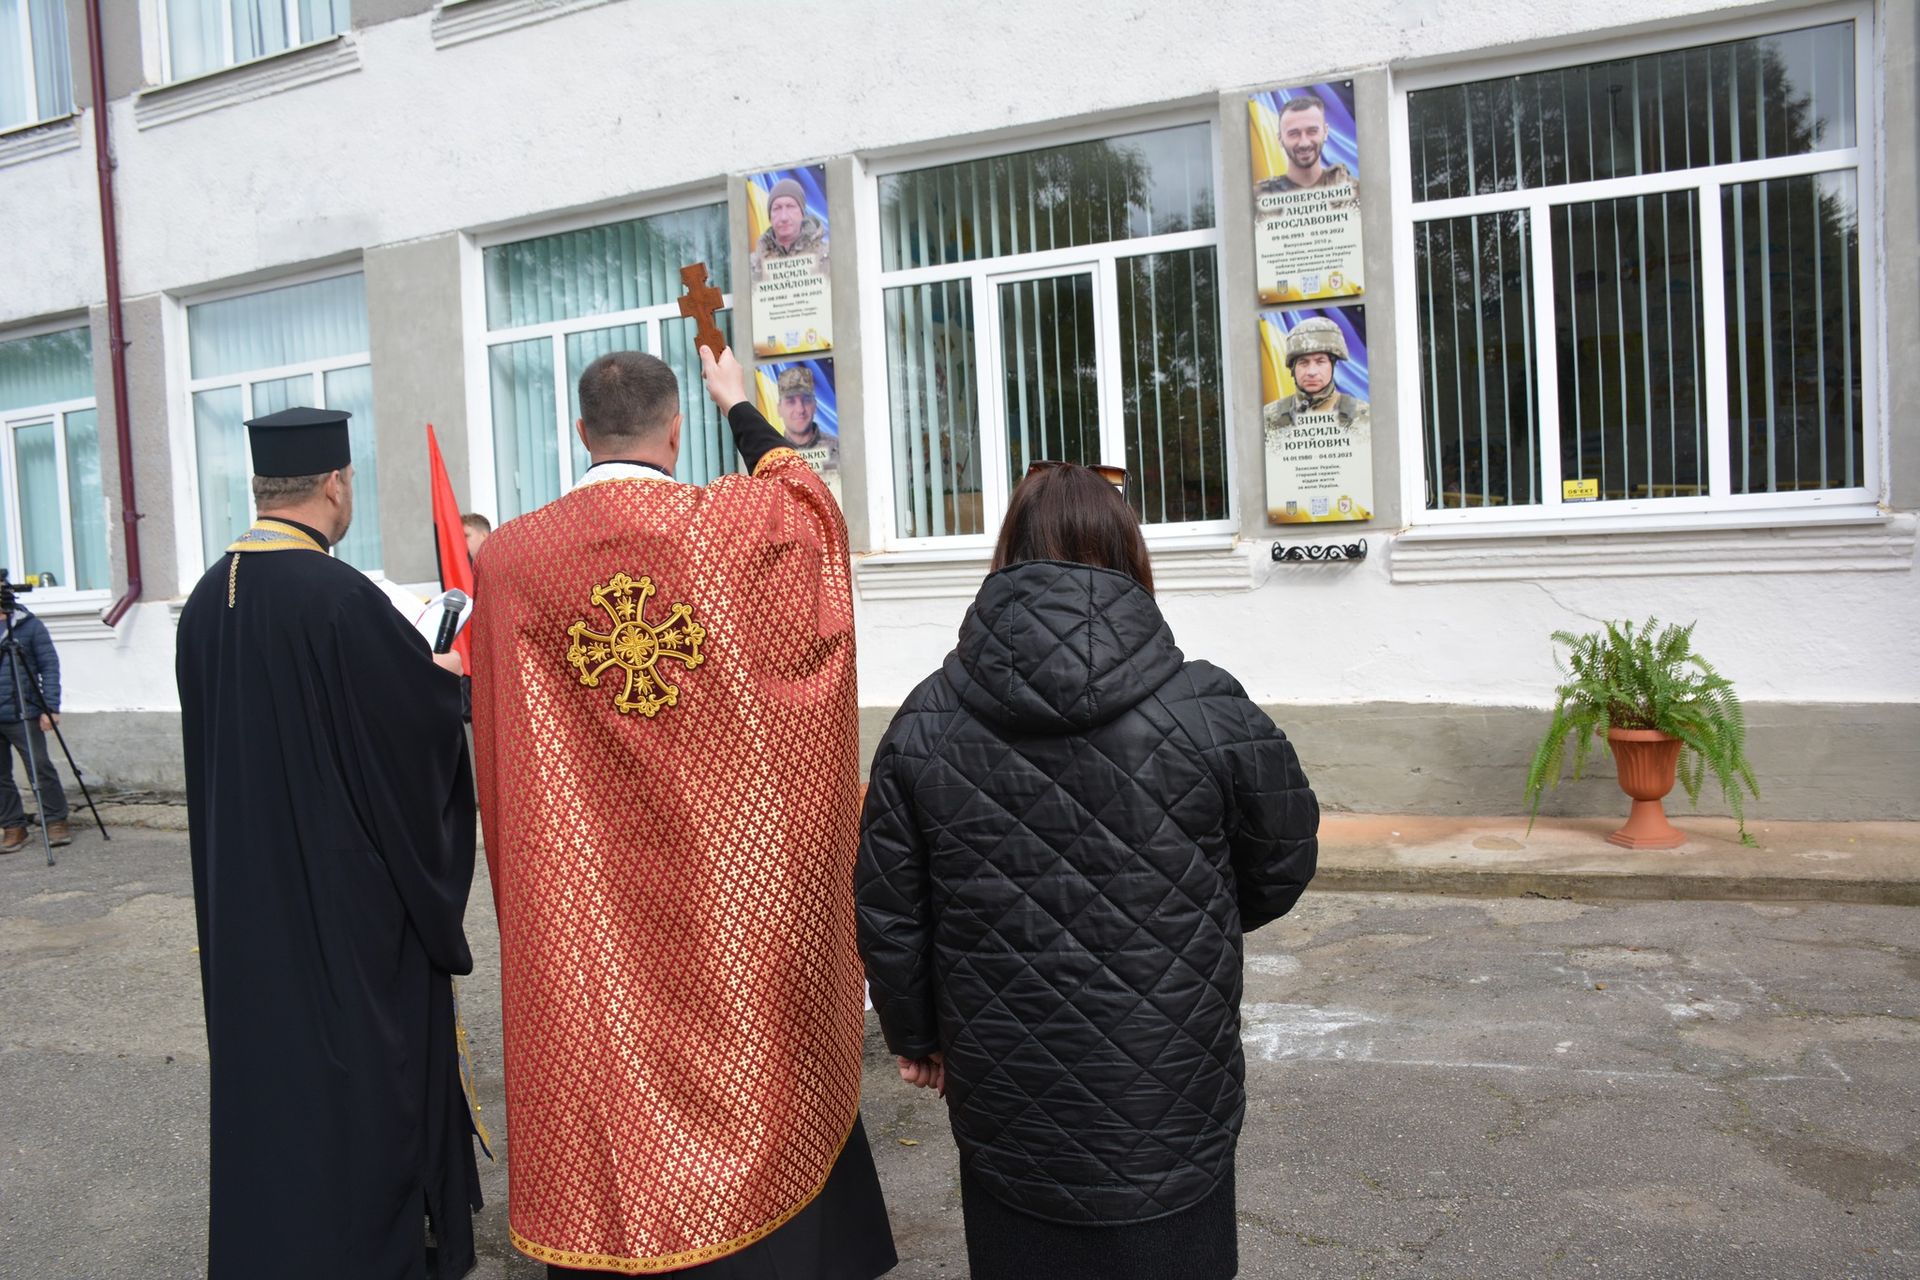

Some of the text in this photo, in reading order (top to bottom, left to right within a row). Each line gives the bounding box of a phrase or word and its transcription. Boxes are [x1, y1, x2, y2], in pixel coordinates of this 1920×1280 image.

[1261, 186, 1351, 207] СИНОВЕРСЬКИЙ
[1286, 202, 1327, 216] АНДРІЙ
[1267, 213, 1348, 231] ЯРОСЛАВОВИЧ
[767, 257, 813, 271] ПЕРЕДРУК
[773, 269, 808, 280] ВАСИЛЬ
[760, 277, 823, 292] МИХАЙЛОВИЧ
[1297, 414, 1335, 425] ЗІНИК
[1293, 426, 1341, 438] ВАСИЛЬ
[1285, 438, 1350, 450] ЮРІЙОВИЧ
